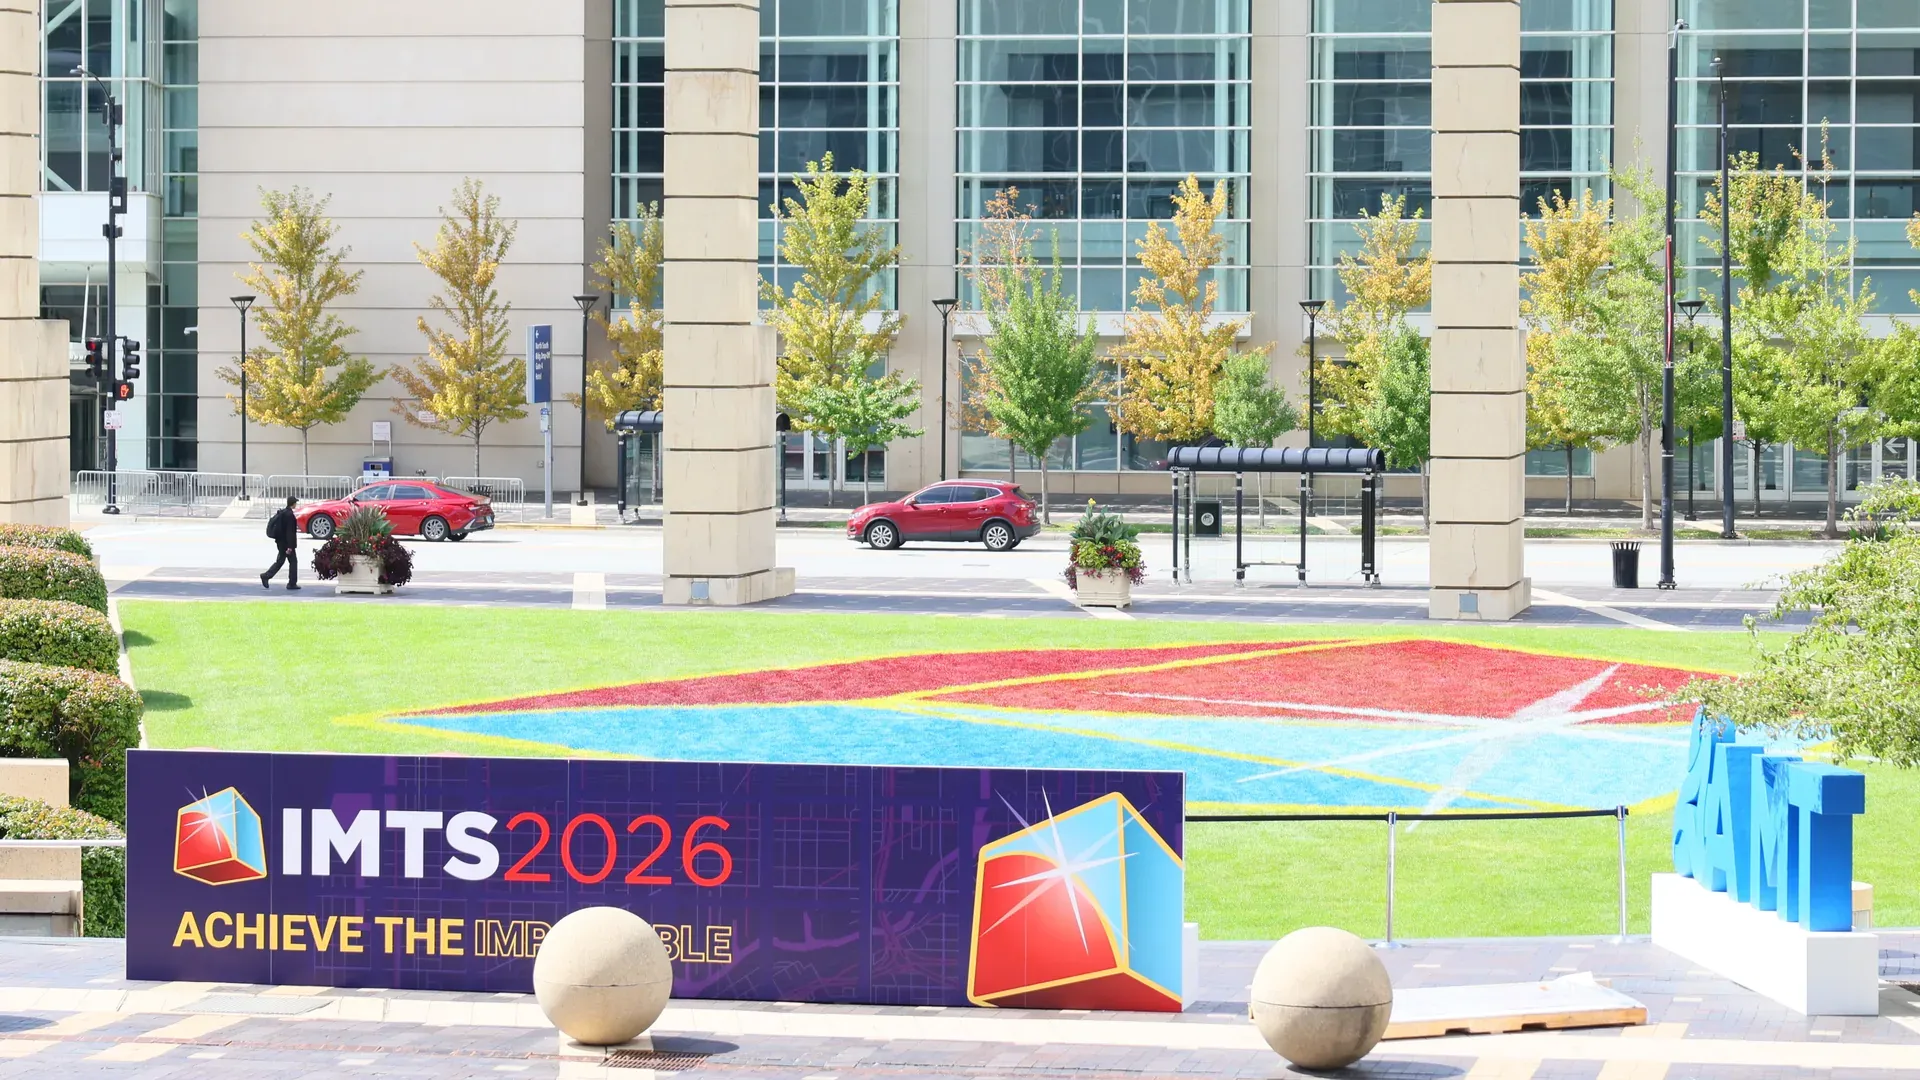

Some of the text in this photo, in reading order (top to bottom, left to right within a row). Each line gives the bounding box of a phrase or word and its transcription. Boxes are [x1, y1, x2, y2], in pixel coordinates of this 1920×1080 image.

[172, 911, 732, 964] ACHIEVE THE IMPBLE
